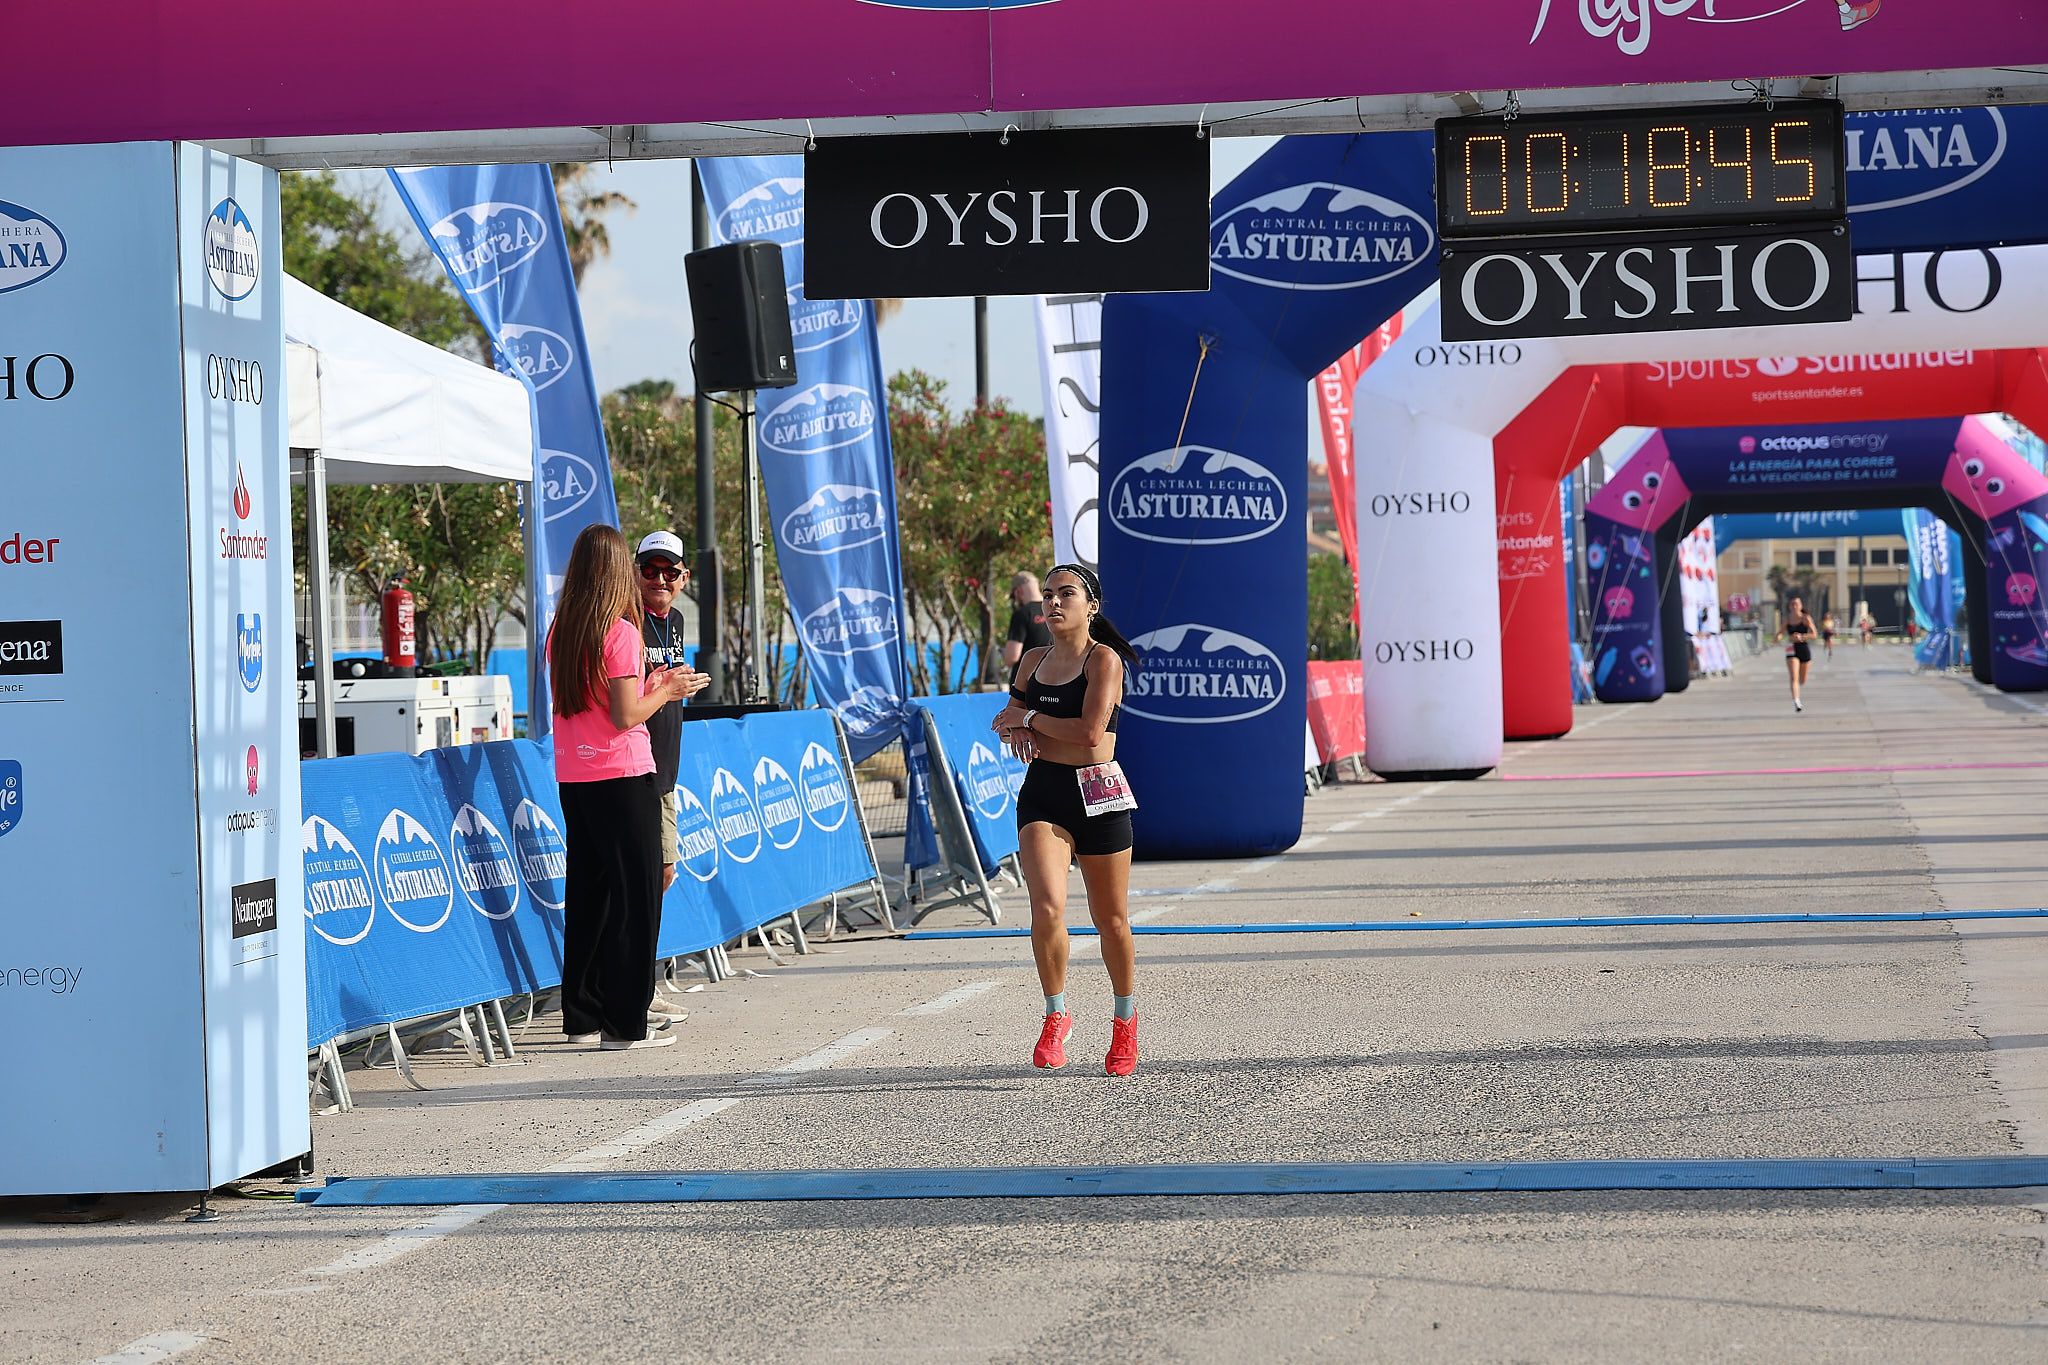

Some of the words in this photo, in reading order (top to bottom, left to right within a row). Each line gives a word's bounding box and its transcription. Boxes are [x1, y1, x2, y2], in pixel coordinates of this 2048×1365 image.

[1466, 122, 1815, 216] 00:18:45
[870, 186, 1149, 249] OYSHO
[1250, 218, 1326, 230] CENTRAL
[1335, 219, 1411, 232] LECHERA
[208, 230, 255, 278] ASTURIANA
[1211, 222, 1414, 263] ASTURIANA
[1461, 238, 1831, 326] OYSHO
[1415, 343, 1522, 367] OYSHO
[1647, 356, 1750, 387] Sports
[1804, 349, 1975, 375] Santander
[207, 354, 263, 405] OYSHO
[1752, 385, 1864, 402] sportssantander.es
[1728, 473, 1738, 483] A
[1741, 473, 1757, 483] LA
[1760, 471, 1832, 483] VELOCIDAD
[1834, 471, 1851, 481] DE
[1853, 470, 1870, 480] LA
[1872, 468, 1897, 479] LUZ
[1729, 460, 1746, 472] LA
[1749, 456, 1804, 471] ENERGÍA
[1806, 457, 1841, 469] PARA
[1843, 455, 1895, 467] CORRER
[1116, 482, 1277, 521] ASTURIANA
[1140, 479, 1203, 490] CENTRAL
[1209, 479, 1271, 492] LECHERA
[1372, 490, 1470, 517] OYSHO
[220, 528, 268, 560] Santander
[1140, 657, 1201, 668] CENTRAL
[1208, 658, 1270, 670] LECHERA
[1375, 638, 1473, 664] OYSHO
[1039, 695, 1060, 703] OYSHO
[413, 849, 438, 862] LECHERA
[457, 848, 516, 892] ASTURIANA
[383, 856, 449, 904] ASTURIANA
[234, 895, 274, 928] Neutrogena
